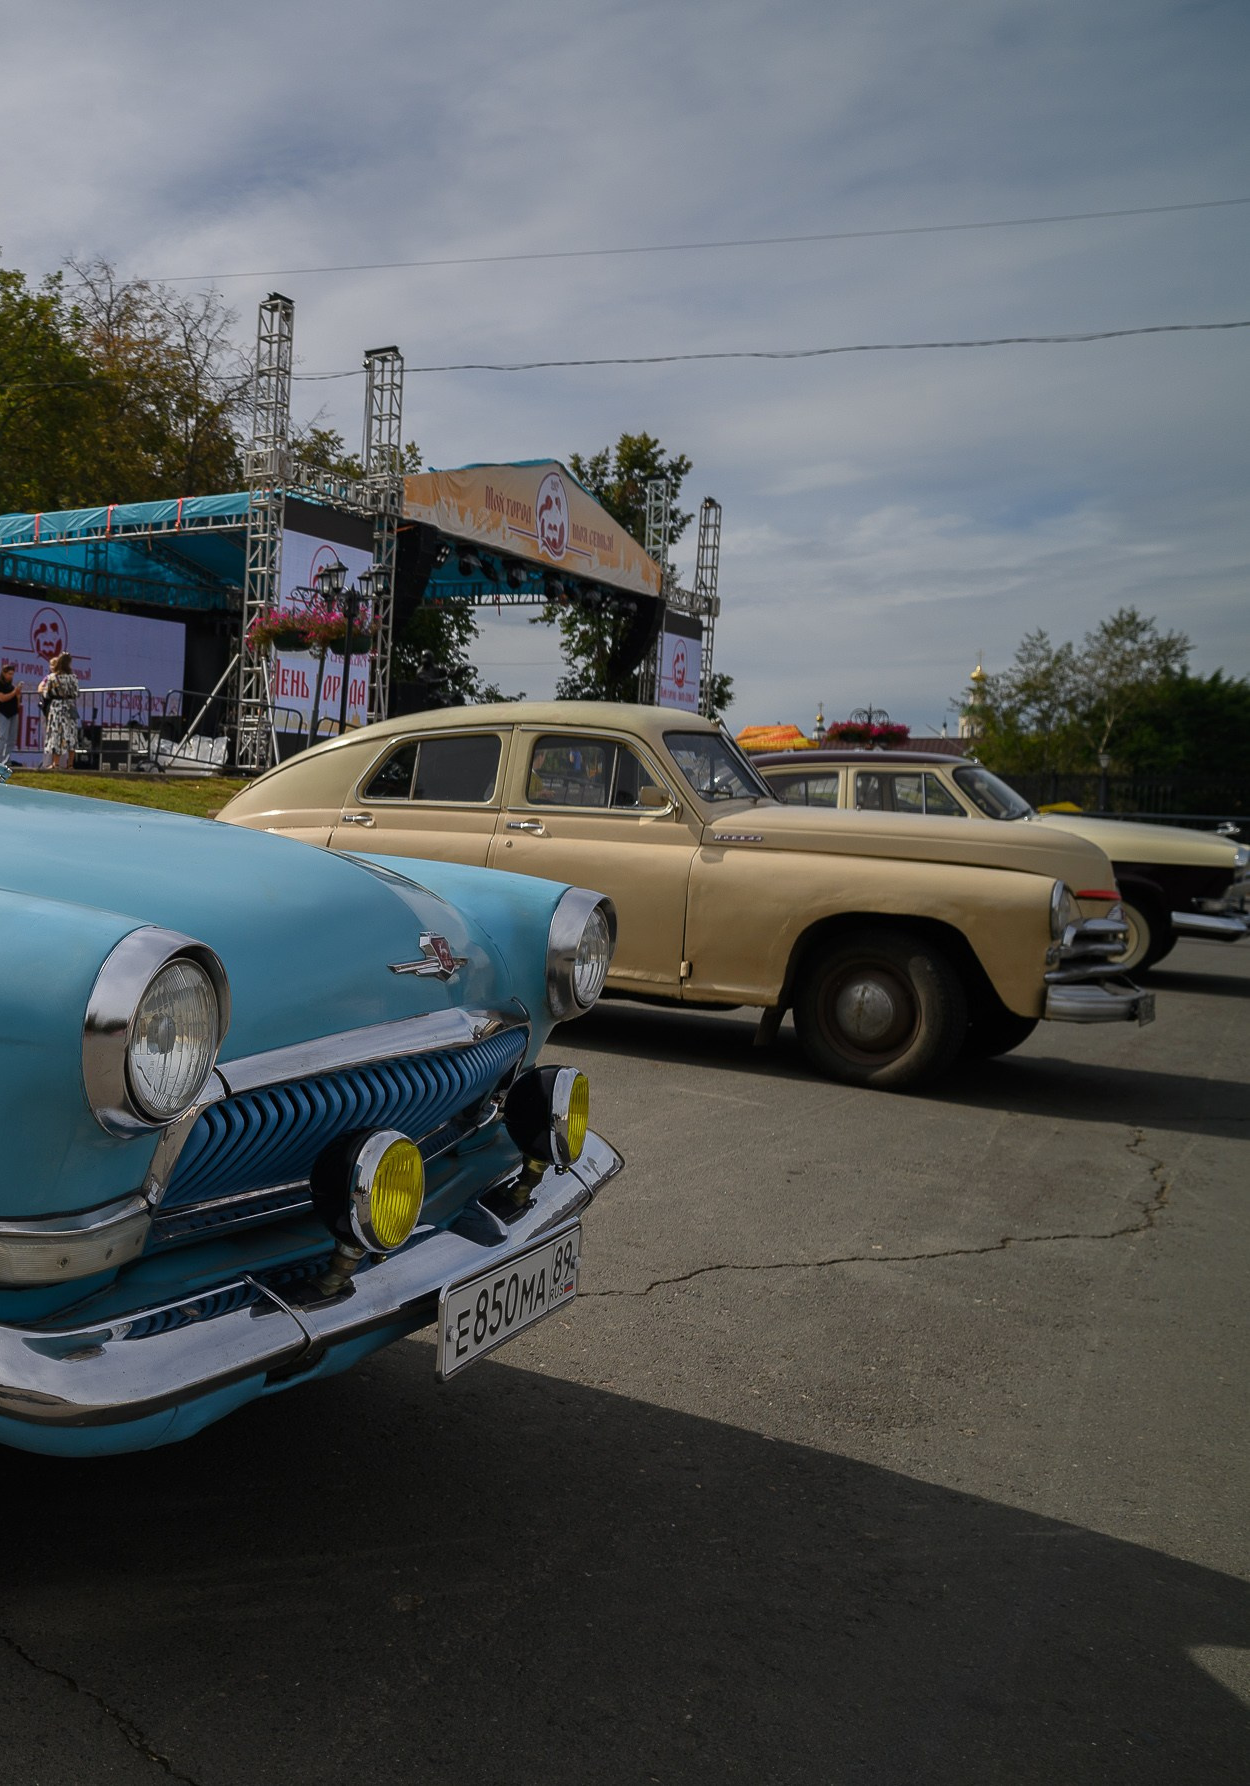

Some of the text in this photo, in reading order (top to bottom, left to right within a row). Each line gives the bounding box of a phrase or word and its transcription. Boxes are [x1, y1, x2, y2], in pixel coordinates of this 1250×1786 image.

[316, 674, 365, 707] ОРДА
[553, 1240, 573, 1285] 89
[550, 1282, 565, 1301] RUS
